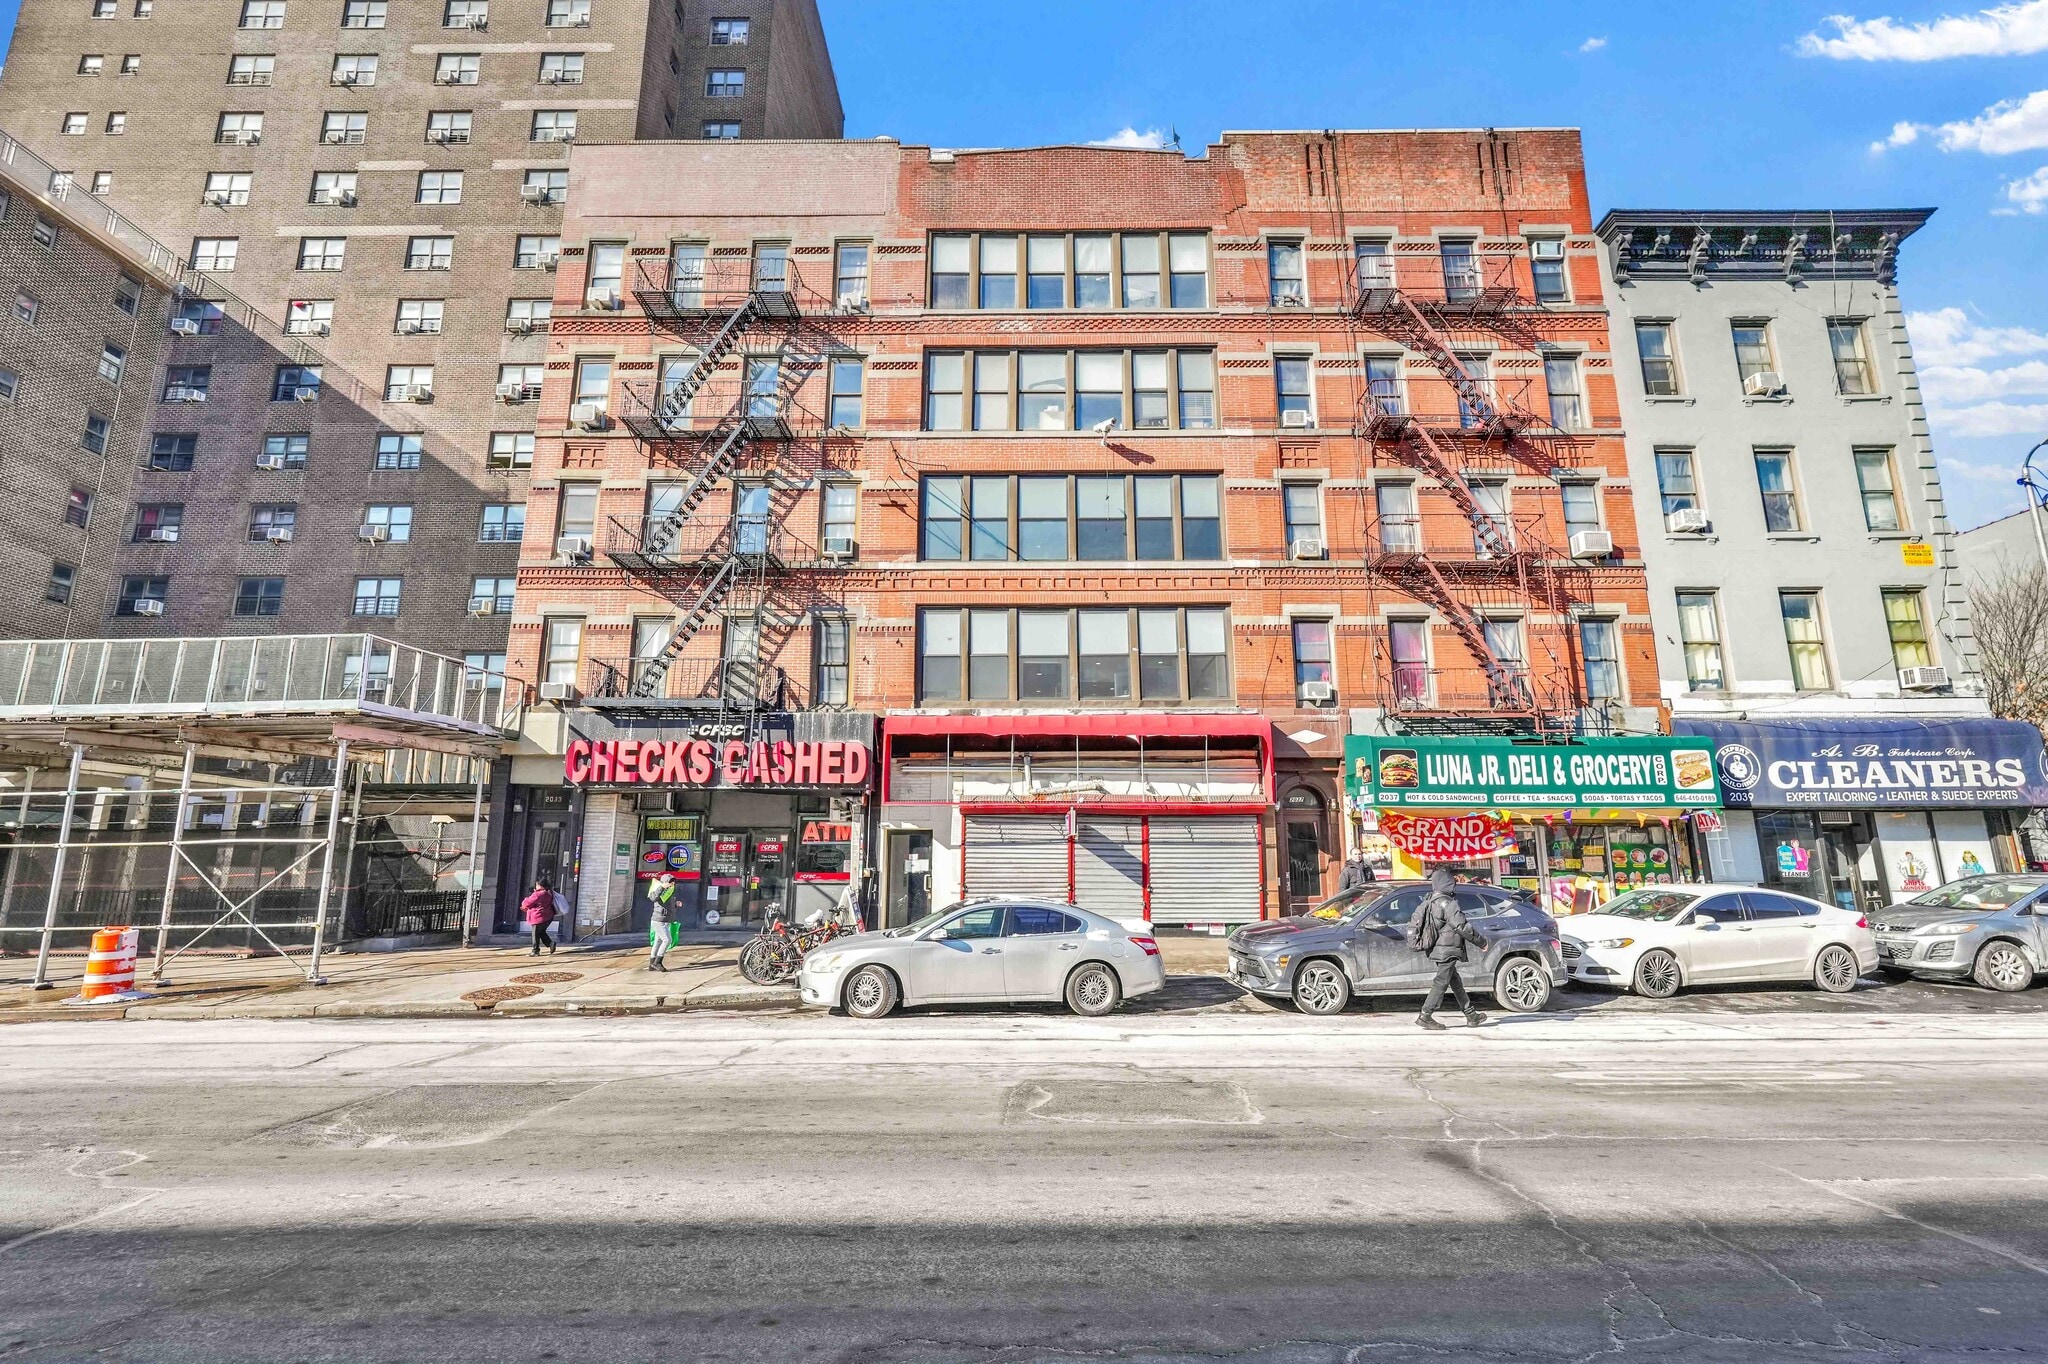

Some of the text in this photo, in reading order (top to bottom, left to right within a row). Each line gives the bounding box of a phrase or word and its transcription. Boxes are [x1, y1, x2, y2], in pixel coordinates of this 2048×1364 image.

[699, 724, 746, 737] CFSC
[1721, 746, 1751, 756] EXPERT
[1811, 743, 1976, 759] A. B. Fabricare Corp.
[565, 739, 869, 785] CHECKS CASHED
[1425, 754, 1652, 786] LUNA JR. DELI & GROCERY
[1654, 756, 1667, 784] CORP.
[1767, 758, 2027, 790] CLEANERS
[1721, 773, 1758, 788] TAILORING
[1445, 794, 1486, 802] SANDWICHES
[1729, 792, 1754, 802] 2039
[1786, 791, 1821, 802] EXPERT
[1823, 791, 1878, 802] TAILORING
[1886, 791, 1928, 801] LEATHER
[1931, 791, 1940, 801] &
[1942, 790, 1974, 800] SUEDE
[1976, 789, 2019, 800] EXPERTS
[647, 819, 690, 830] WESTERN
[802, 821, 852, 843] ATM
[1396, 818, 1485, 837] GRAND
[659, 829, 690, 840] UNION
[1389, 832, 1498, 853] OPENING
[1552, 842, 1575, 850] ATM
